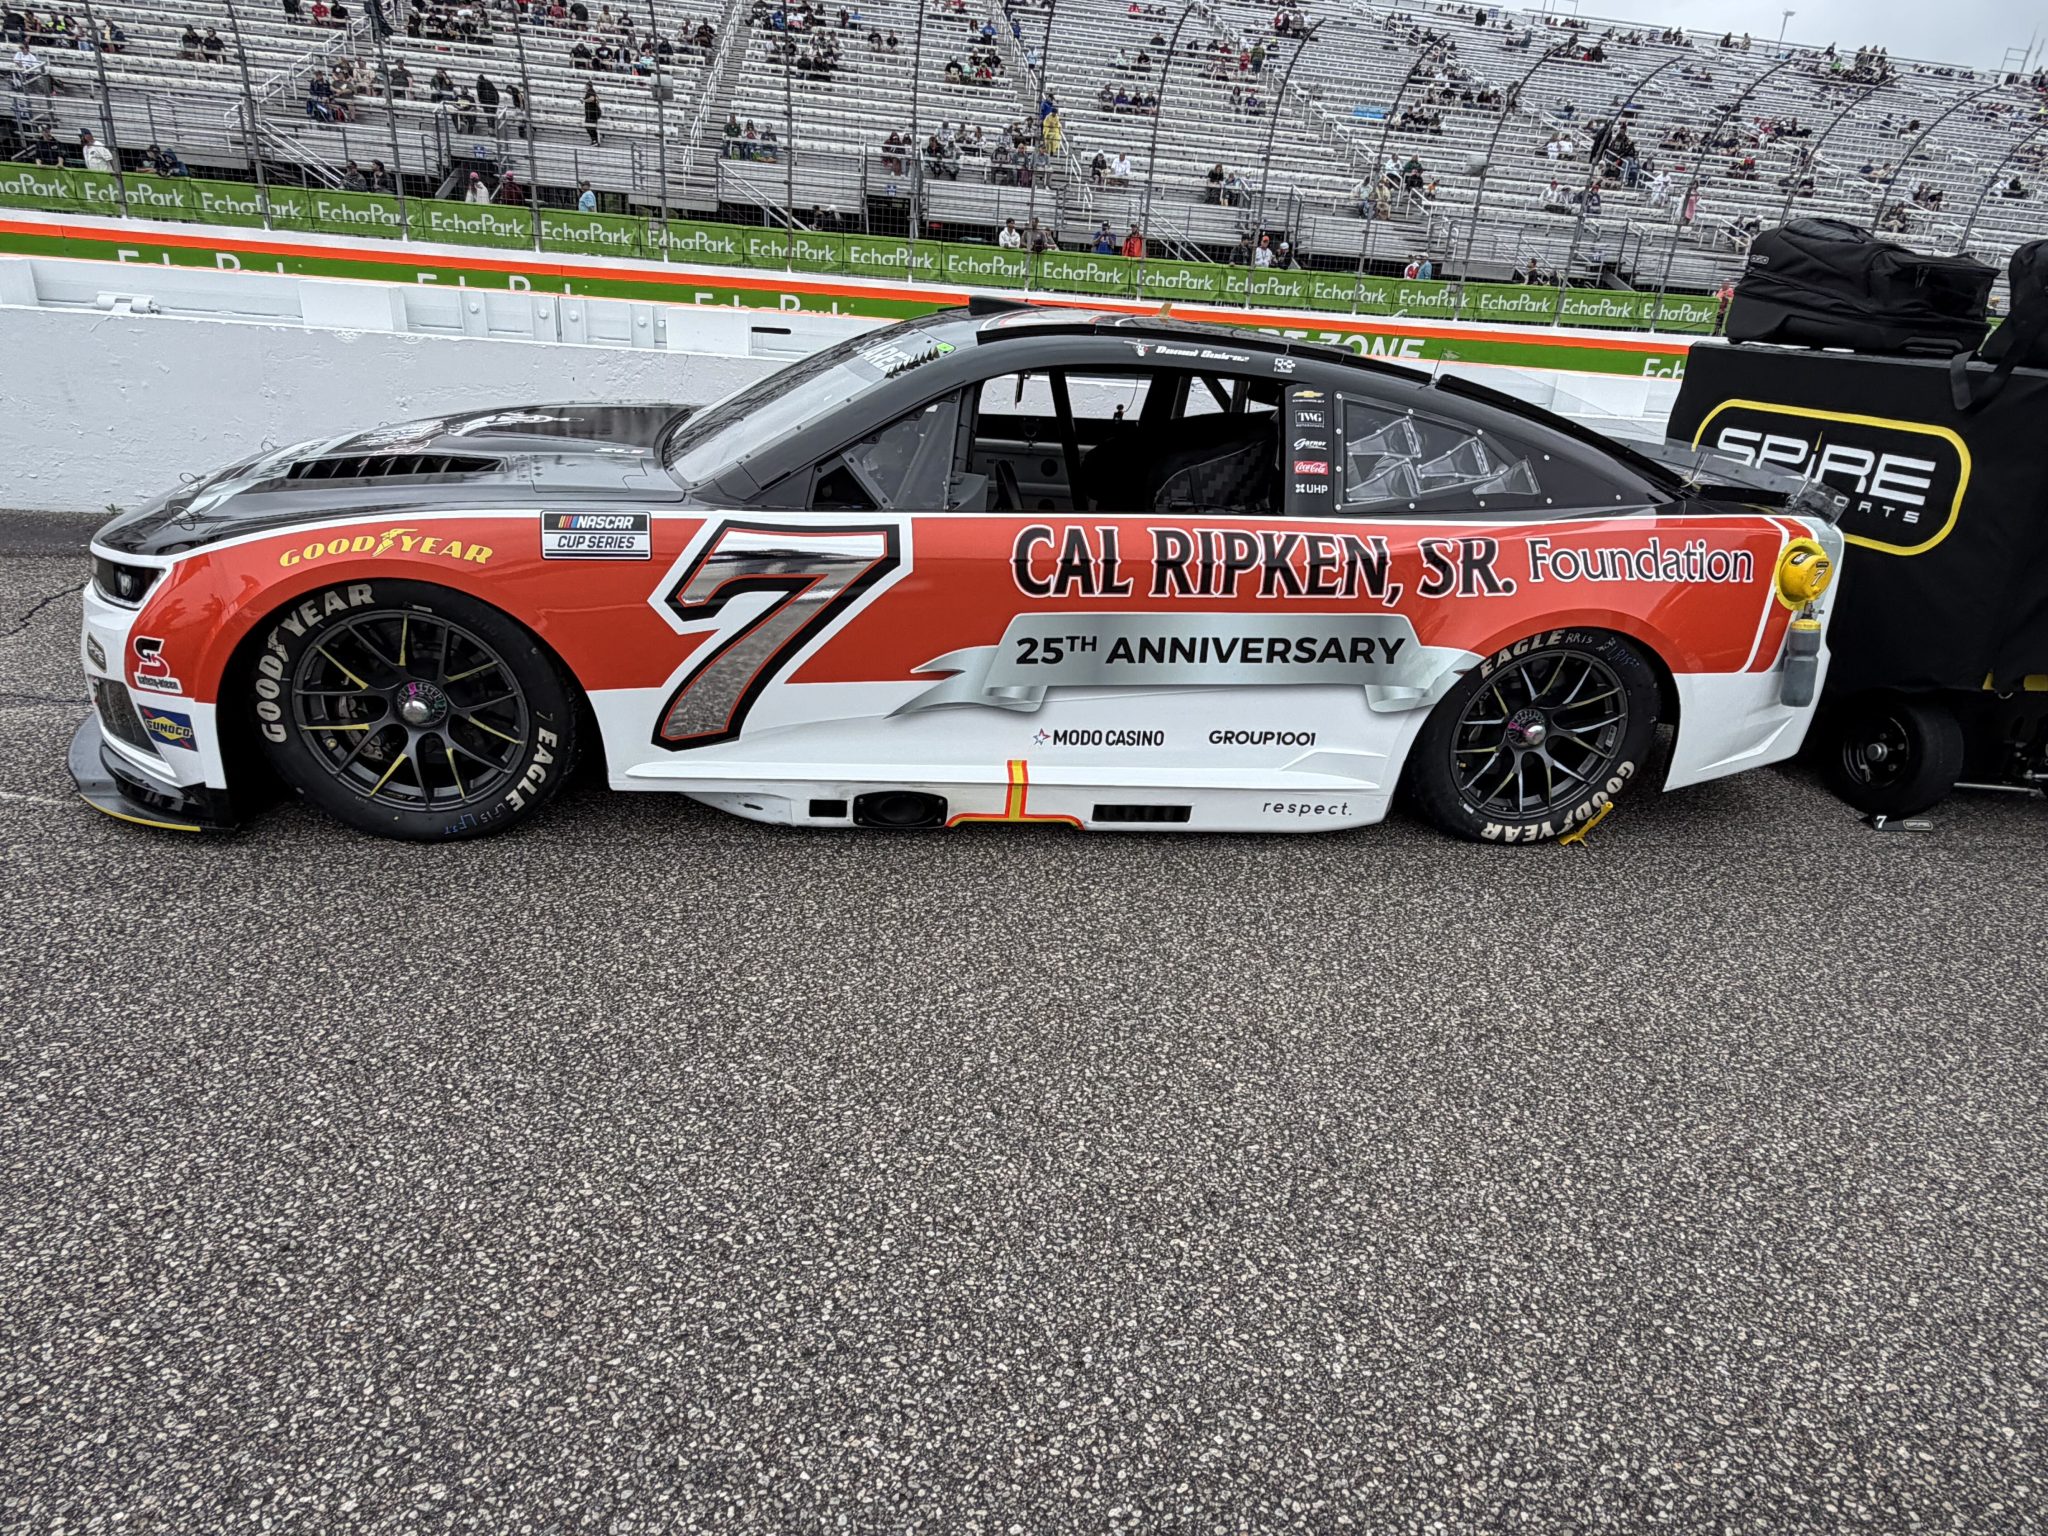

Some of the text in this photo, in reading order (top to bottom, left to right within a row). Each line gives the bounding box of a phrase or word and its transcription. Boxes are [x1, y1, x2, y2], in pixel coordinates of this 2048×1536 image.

[84, 182, 184, 207] EchoPark
[431, 212, 525, 237] EchoPark
[541, 221, 632, 247] EchoPark
[750, 238, 836, 262] EchoPark
[850, 246, 934, 269] EchoPark
[948, 254, 1027, 278] EchoPark
[1043, 261, 1123, 284] EchoPark
[1136, 269, 1214, 291] EchoPark
[1226, 276, 1302, 297] EchoPark
[1314, 282, 1387, 305] EchoPark
[1480, 293, 1551, 313] EchoPark
[1561, 298, 1633, 319] EchoPark
[1298, 412, 1322, 422] TWG
[1717, 427, 1936, 506] SPIRE
[1306, 483, 1328, 494] UHP
[576, 515, 634, 530] NASCAR
[279, 528, 494, 568] GOODYEAR
[557, 535, 636, 549] CUP SERIES
[1010, 523, 1754, 608] CAL RIPKEN, SR. Foundation
[1811, 568, 1827, 587] 7
[651, 519, 901, 753] 7
[1016, 634, 1406, 665] 25TH ANNIVERSARY
[1479, 629, 1567, 679] EAGLE
[256, 583, 376, 743] GOODYEAR
[146, 718, 191, 739] SUNOCO
[1053, 729, 1165, 747] MODO CASINO
[1208, 730, 1317, 747] GROUP1001
[504, 727, 558, 812] EAGLE
[1262, 802, 1352, 817] respect.
[1876, 815, 1887, 829] 7
